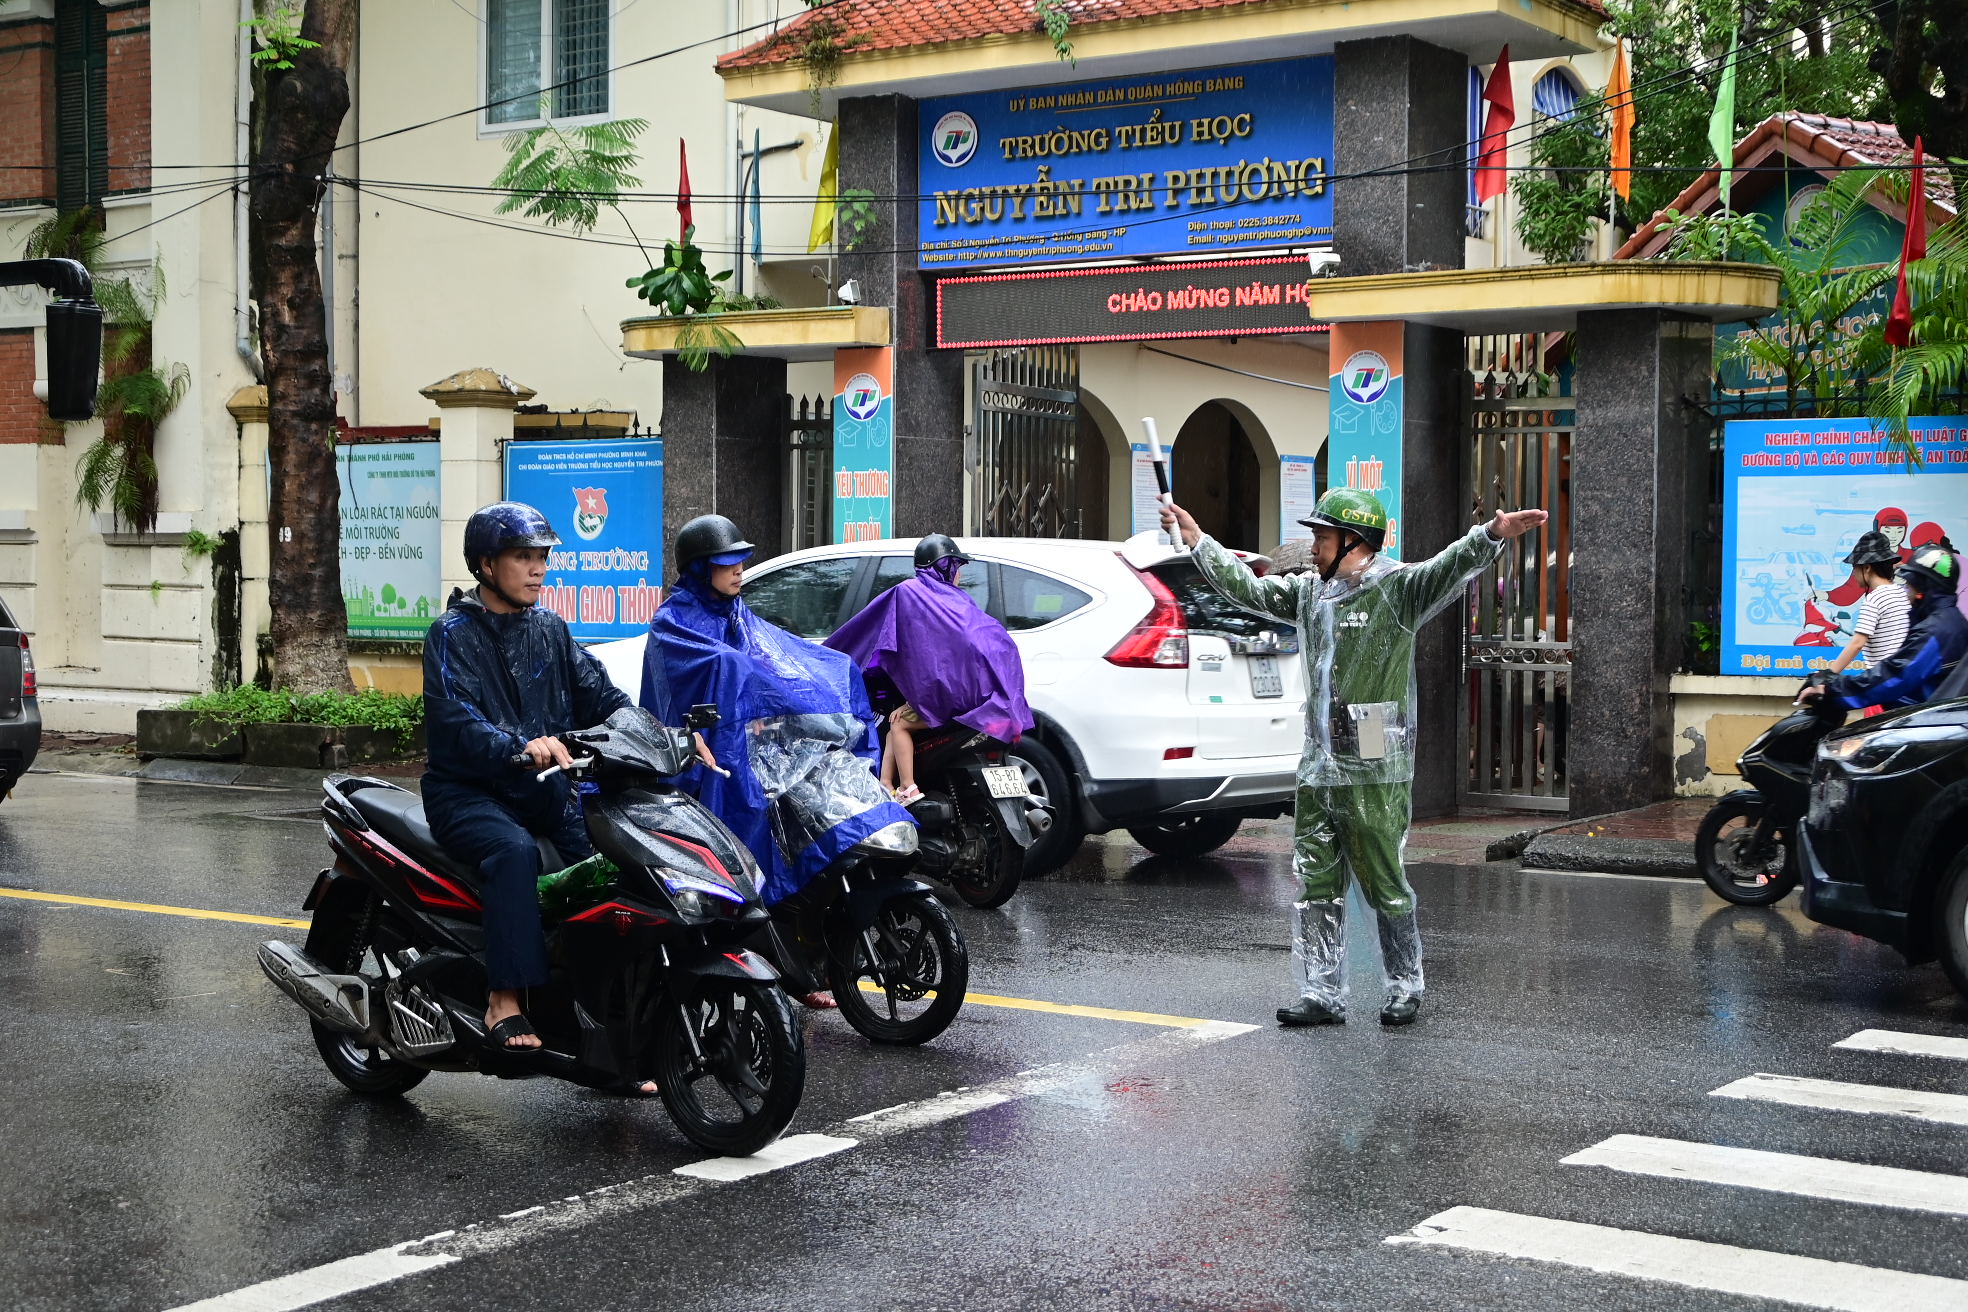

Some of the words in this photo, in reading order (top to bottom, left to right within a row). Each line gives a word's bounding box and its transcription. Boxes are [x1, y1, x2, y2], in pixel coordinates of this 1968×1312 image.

[1030, 96, 1055, 110] BAN
[1059, 90, 1094, 106] NHÂN
[1098, 87, 1124, 103] DÂN
[1128, 83, 1163, 101] QUẬN
[1167, 78, 1202, 96] HỒNG
[1206, 76, 1244, 92] BÀNG
[1001, 125, 1110, 159] TRƯỜNG
[1115, 108, 1182, 148] TIỂU
[1190, 113, 1252, 144] HỌC
[933, 165, 1084, 225] NGUYỄN
[1092, 172, 1154, 212] TRI
[1164, 157, 1326, 206] PHƯƠNG
[1113, 227, 1126, 237] HP
[1188, 220, 1208, 232] Điện
[1210, 219, 1235, 231] thoại:
[1238, 214, 1301, 228] 0225.3842774
[1187, 234, 1215, 244] Email:
[922, 252, 956, 263] Website:
[1107, 288, 1163, 313] CHÀO
[1167, 285, 1230, 310] MỪNG
[1235, 281, 1281, 307] NĂM
[1285, 283, 1311, 308] HỌ
[1765, 430, 1811, 446] NGHIÊM
[1926, 426, 1957, 445] LUẬT
[393, 450, 415, 461] PHÒNG
[1742, 450, 1782, 467] ĐƯỜNG
[1784, 450, 1801, 469] BỘ
[1803, 450, 1819, 466] VÀ
[1821, 449, 1846, 466] CÁC
[1849, 451, 1873, 466] QUY
[1926, 449, 1944, 464] AN
[835, 466, 853, 498] YÊU
[853, 468, 889, 498] THƯƠNG
[1346, 455, 1358, 489] VÌ
[1359, 455, 1383, 497] MỘT
[349, 505, 369, 522] LOẠI
[370, 503, 388, 519] RÁC
[390, 505, 404, 522] TẠI
[1341, 508, 1379, 525] CSTT
[345, 523, 363, 540] MÔI
[363, 523, 400, 540] TRƯỜNG
[843, 522, 857, 543] AN
[354, 546, 371, 562] ĐẸP
[397, 543, 423, 560] VỮNG
[580, 546, 649, 571] TRƯỜNG
[539, 578, 577, 623] TOÀN
[580, 585, 616, 624] GIAO
[618, 577, 663, 624] THÔN
[1741, 654, 1771, 671] Đội
[1775, 655, 1804, 669] mũ
[989, 769, 1019, 782] 15-B2
[991, 782, 1027, 796] 646.64
